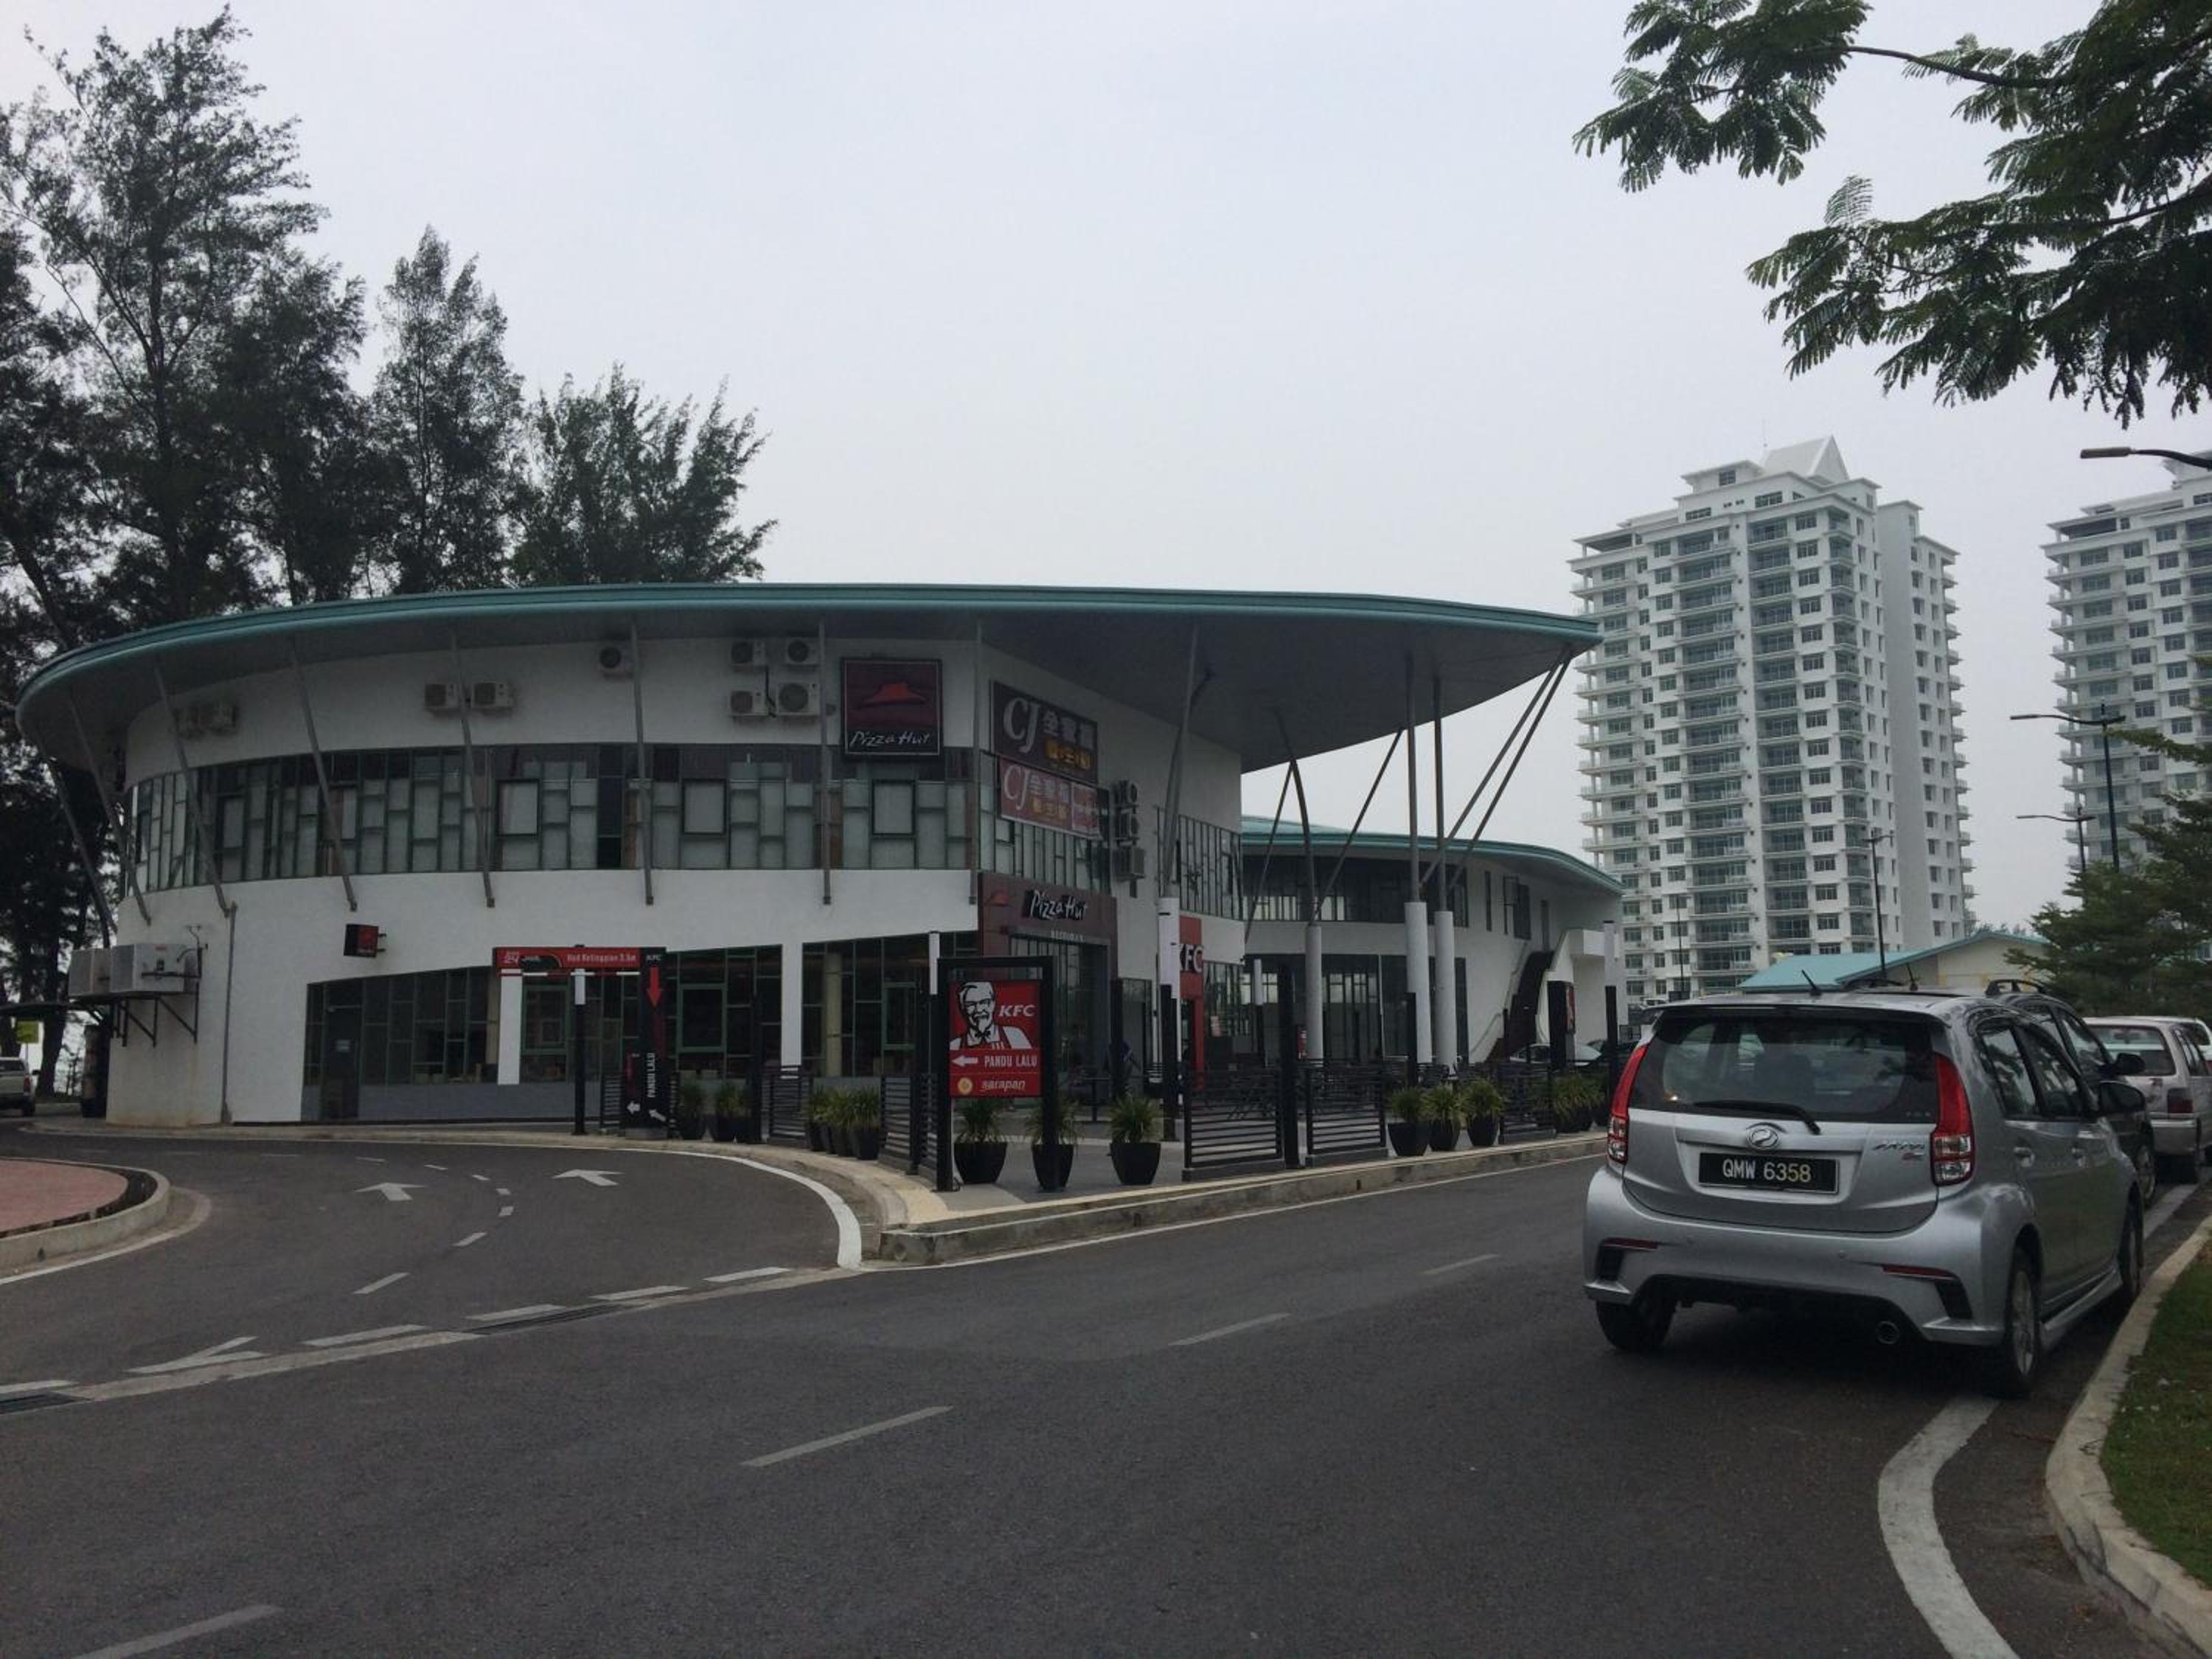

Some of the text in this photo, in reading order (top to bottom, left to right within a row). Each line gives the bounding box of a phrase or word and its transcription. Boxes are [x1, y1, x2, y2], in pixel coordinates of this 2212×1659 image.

[1003, 697, 1040, 753] CJ
[849, 731, 931, 748] Pizza Hut
[1003, 765, 1031, 810] CJ
[1029, 889, 1088, 921] Pizza Hut
[998, 1004, 1035, 1018] KFC
[984, 1055, 1037, 1068] PANDU LALU
[981, 1079, 1026, 1092] sarapan
[1722, 1158, 1812, 1183] QMW 6358
